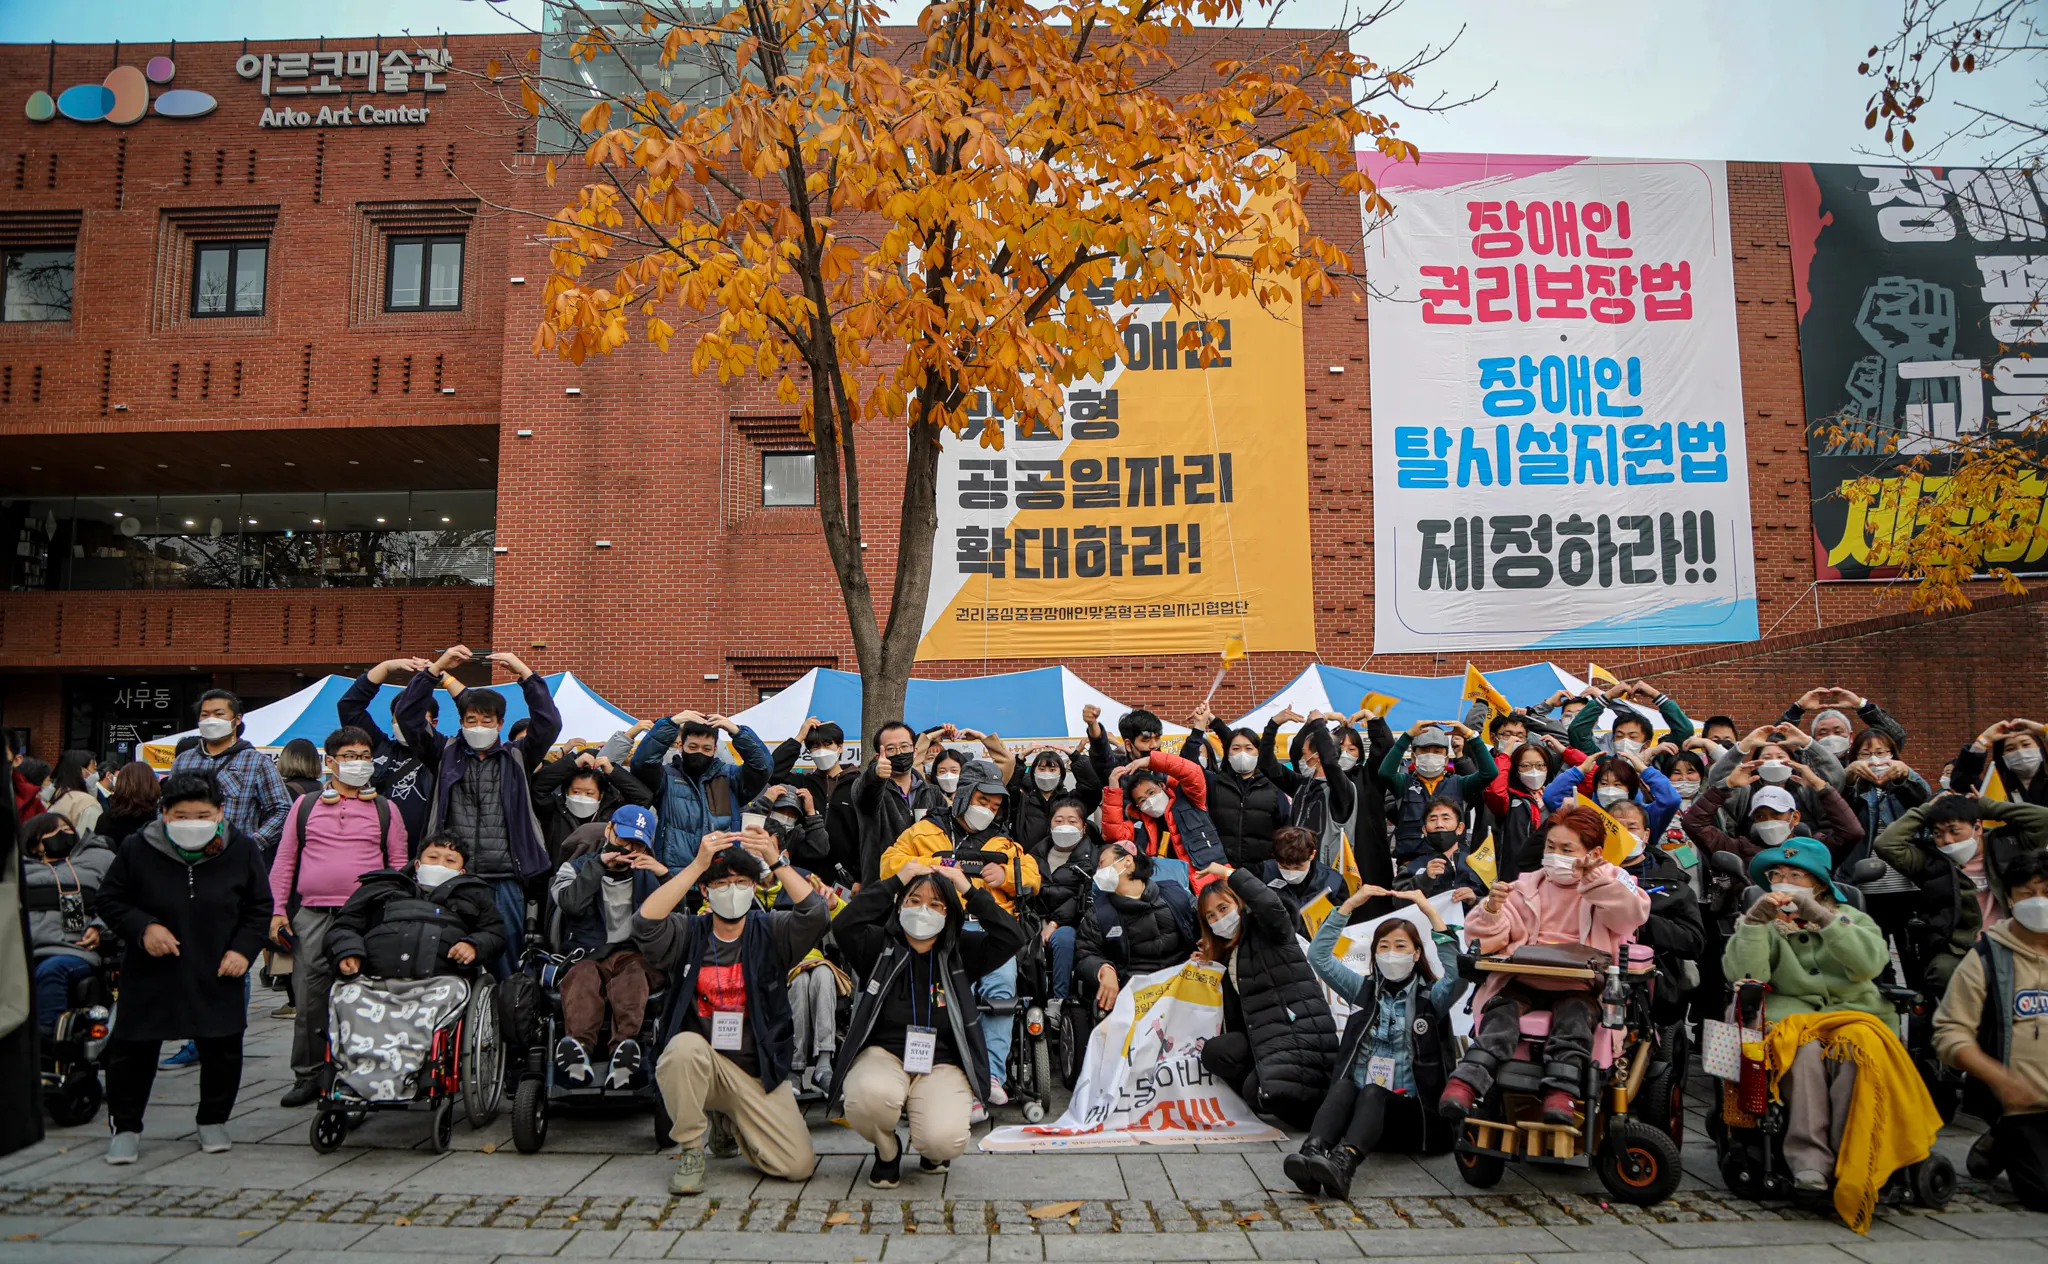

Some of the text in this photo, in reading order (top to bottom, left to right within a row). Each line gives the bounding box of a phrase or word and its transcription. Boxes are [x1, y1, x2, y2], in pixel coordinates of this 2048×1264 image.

[236, 48, 453, 97] 아르코미술관
[259, 104, 430, 127] Arko Art Center
[1466, 200, 1633, 260] 장애인
[1419, 260, 1693, 325] 권리보장법
[1477, 354, 1644, 418] 장애인
[957, 452, 1234, 510] 공공일자리
[1394, 420, 1729, 489] 탈시설지원법
[956, 523, 1202, 579] 확대하라!
[1416, 509, 1718, 592] 제정하라!!
[114, 688, 171, 709] 사무동
